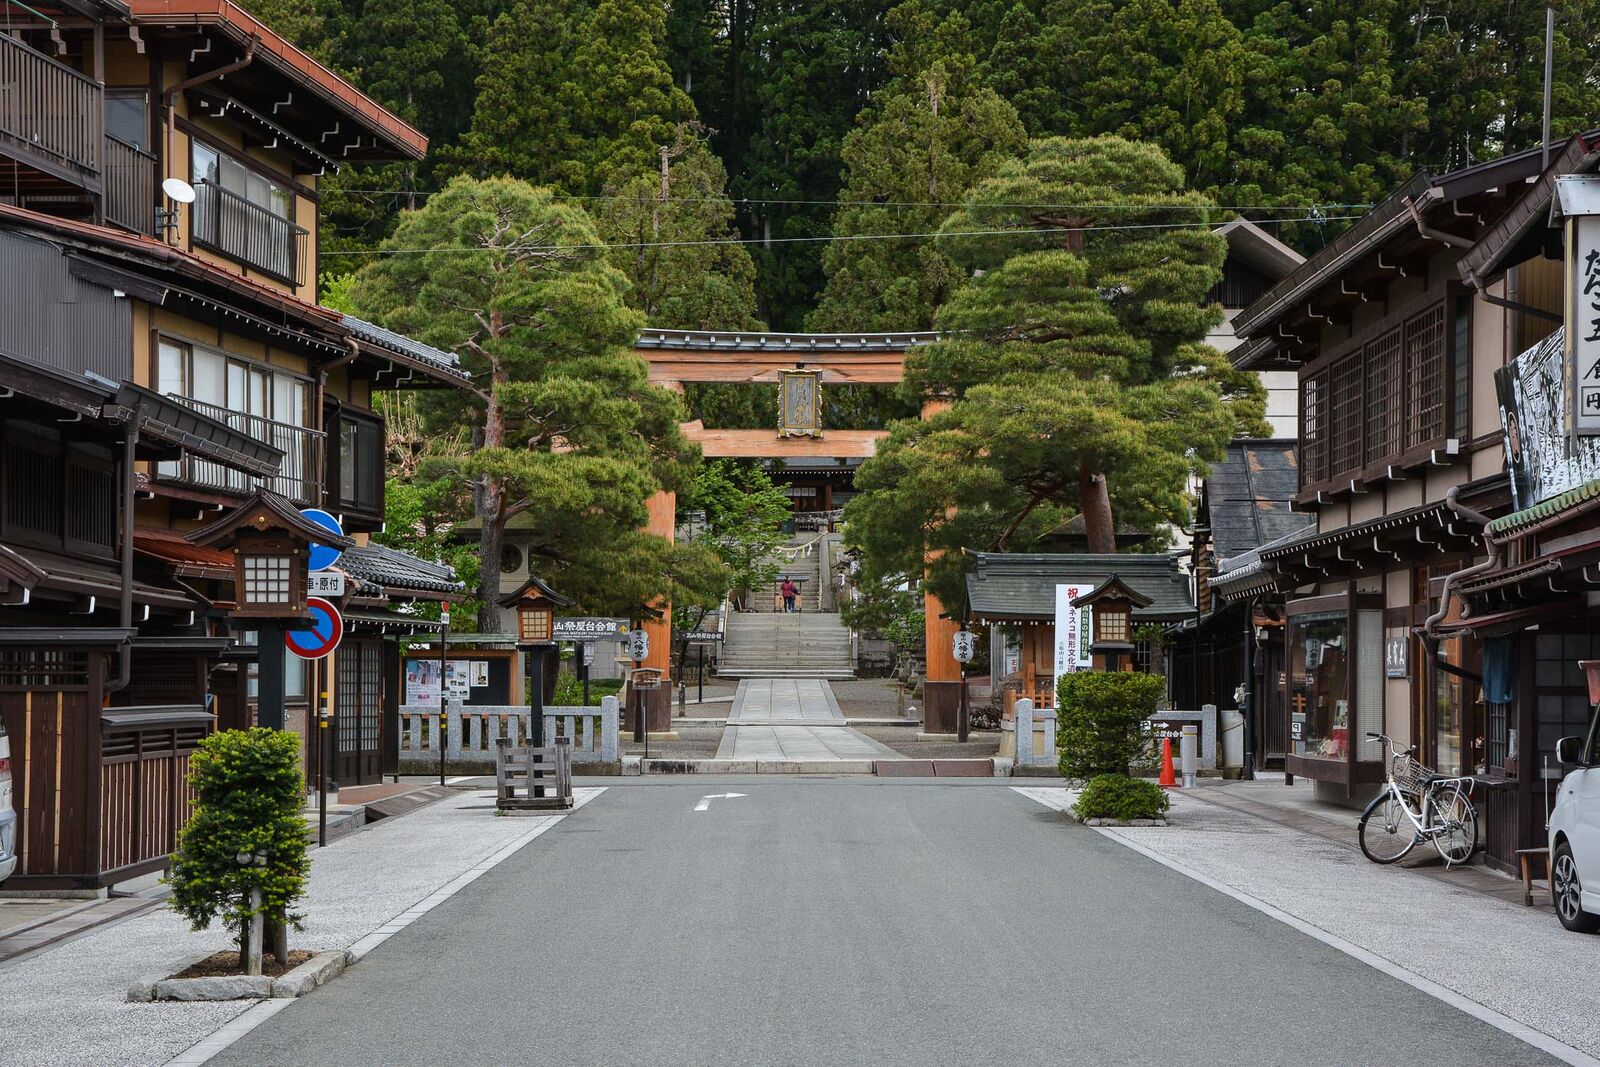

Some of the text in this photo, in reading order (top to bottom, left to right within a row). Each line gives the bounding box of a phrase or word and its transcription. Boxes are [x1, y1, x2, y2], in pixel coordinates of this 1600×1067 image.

[553, 621, 617, 631] 山祭屋台会館
[1067, 588, 1079, 672] 祝 ネスコ無形文化遺
